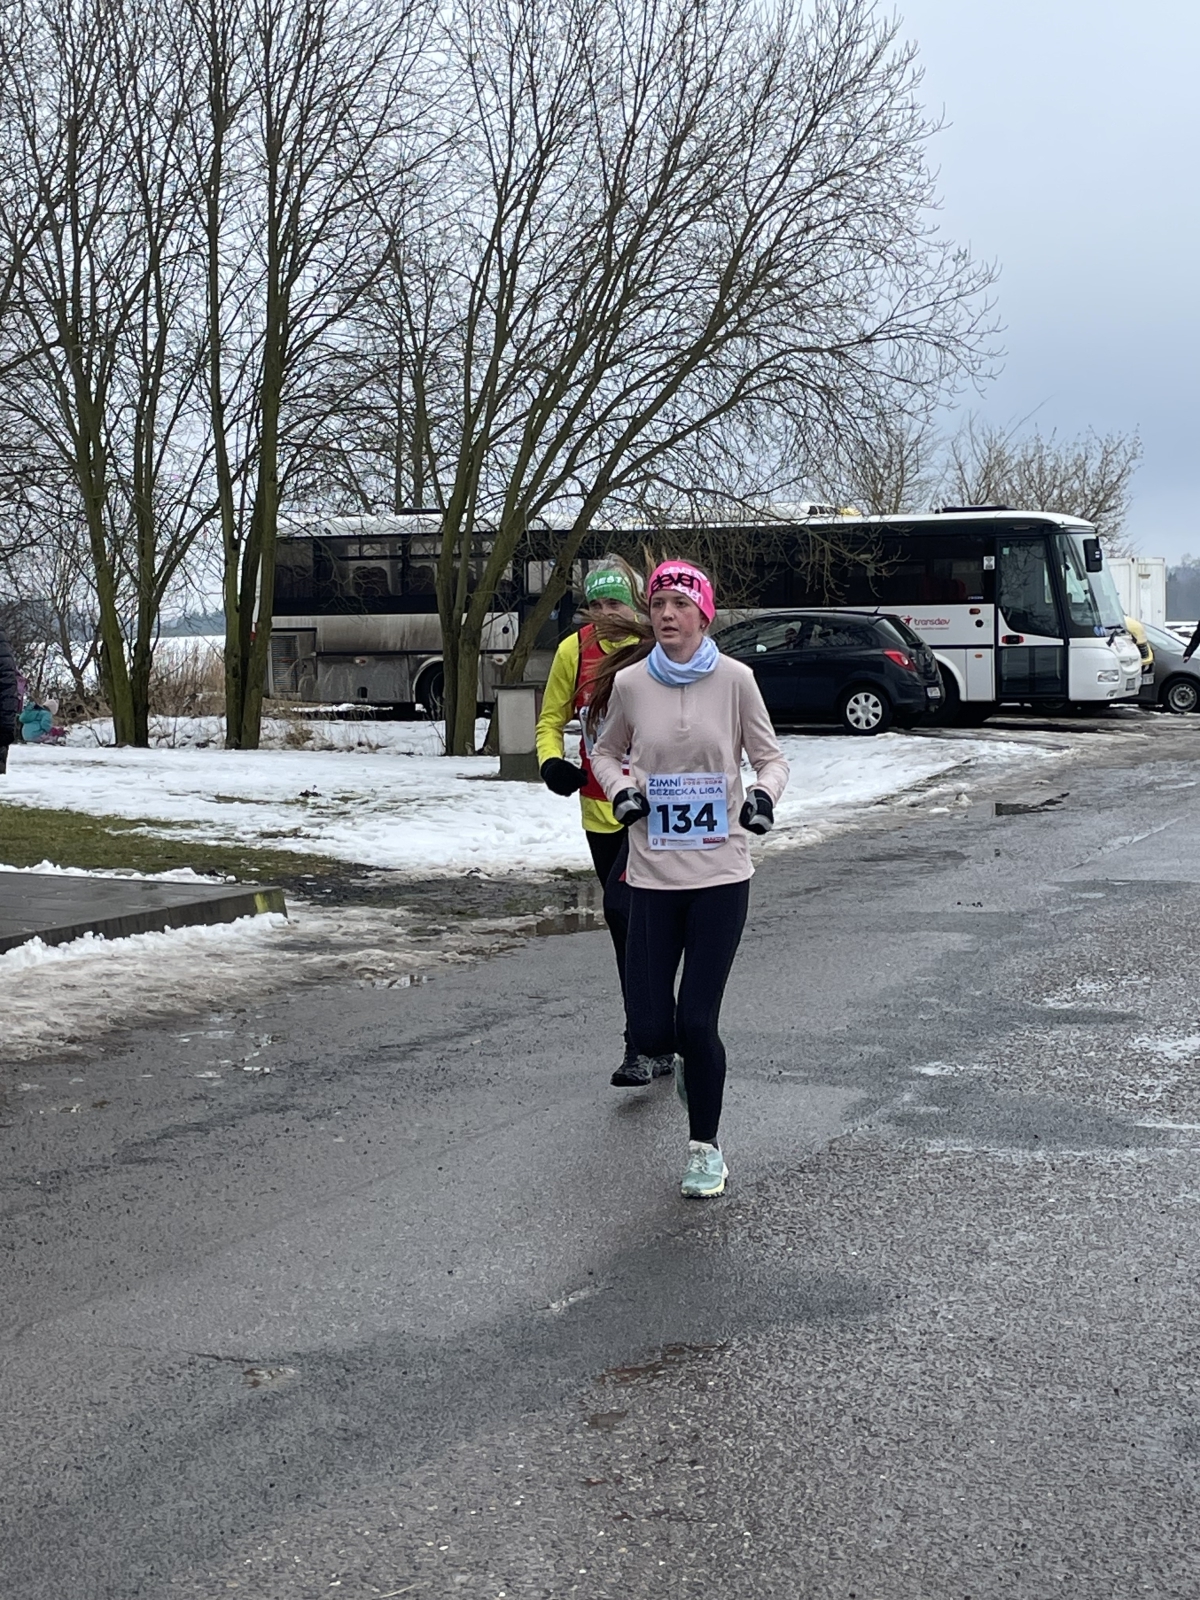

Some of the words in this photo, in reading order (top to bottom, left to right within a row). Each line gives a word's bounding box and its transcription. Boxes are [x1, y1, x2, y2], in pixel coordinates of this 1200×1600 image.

[651, 572, 702, 592] eleven
[914, 617, 951, 626] transdev
[648, 776, 682, 788] ZIMNÍ
[699, 787, 723, 795] LIGA
[656, 803, 718, 834] 134
